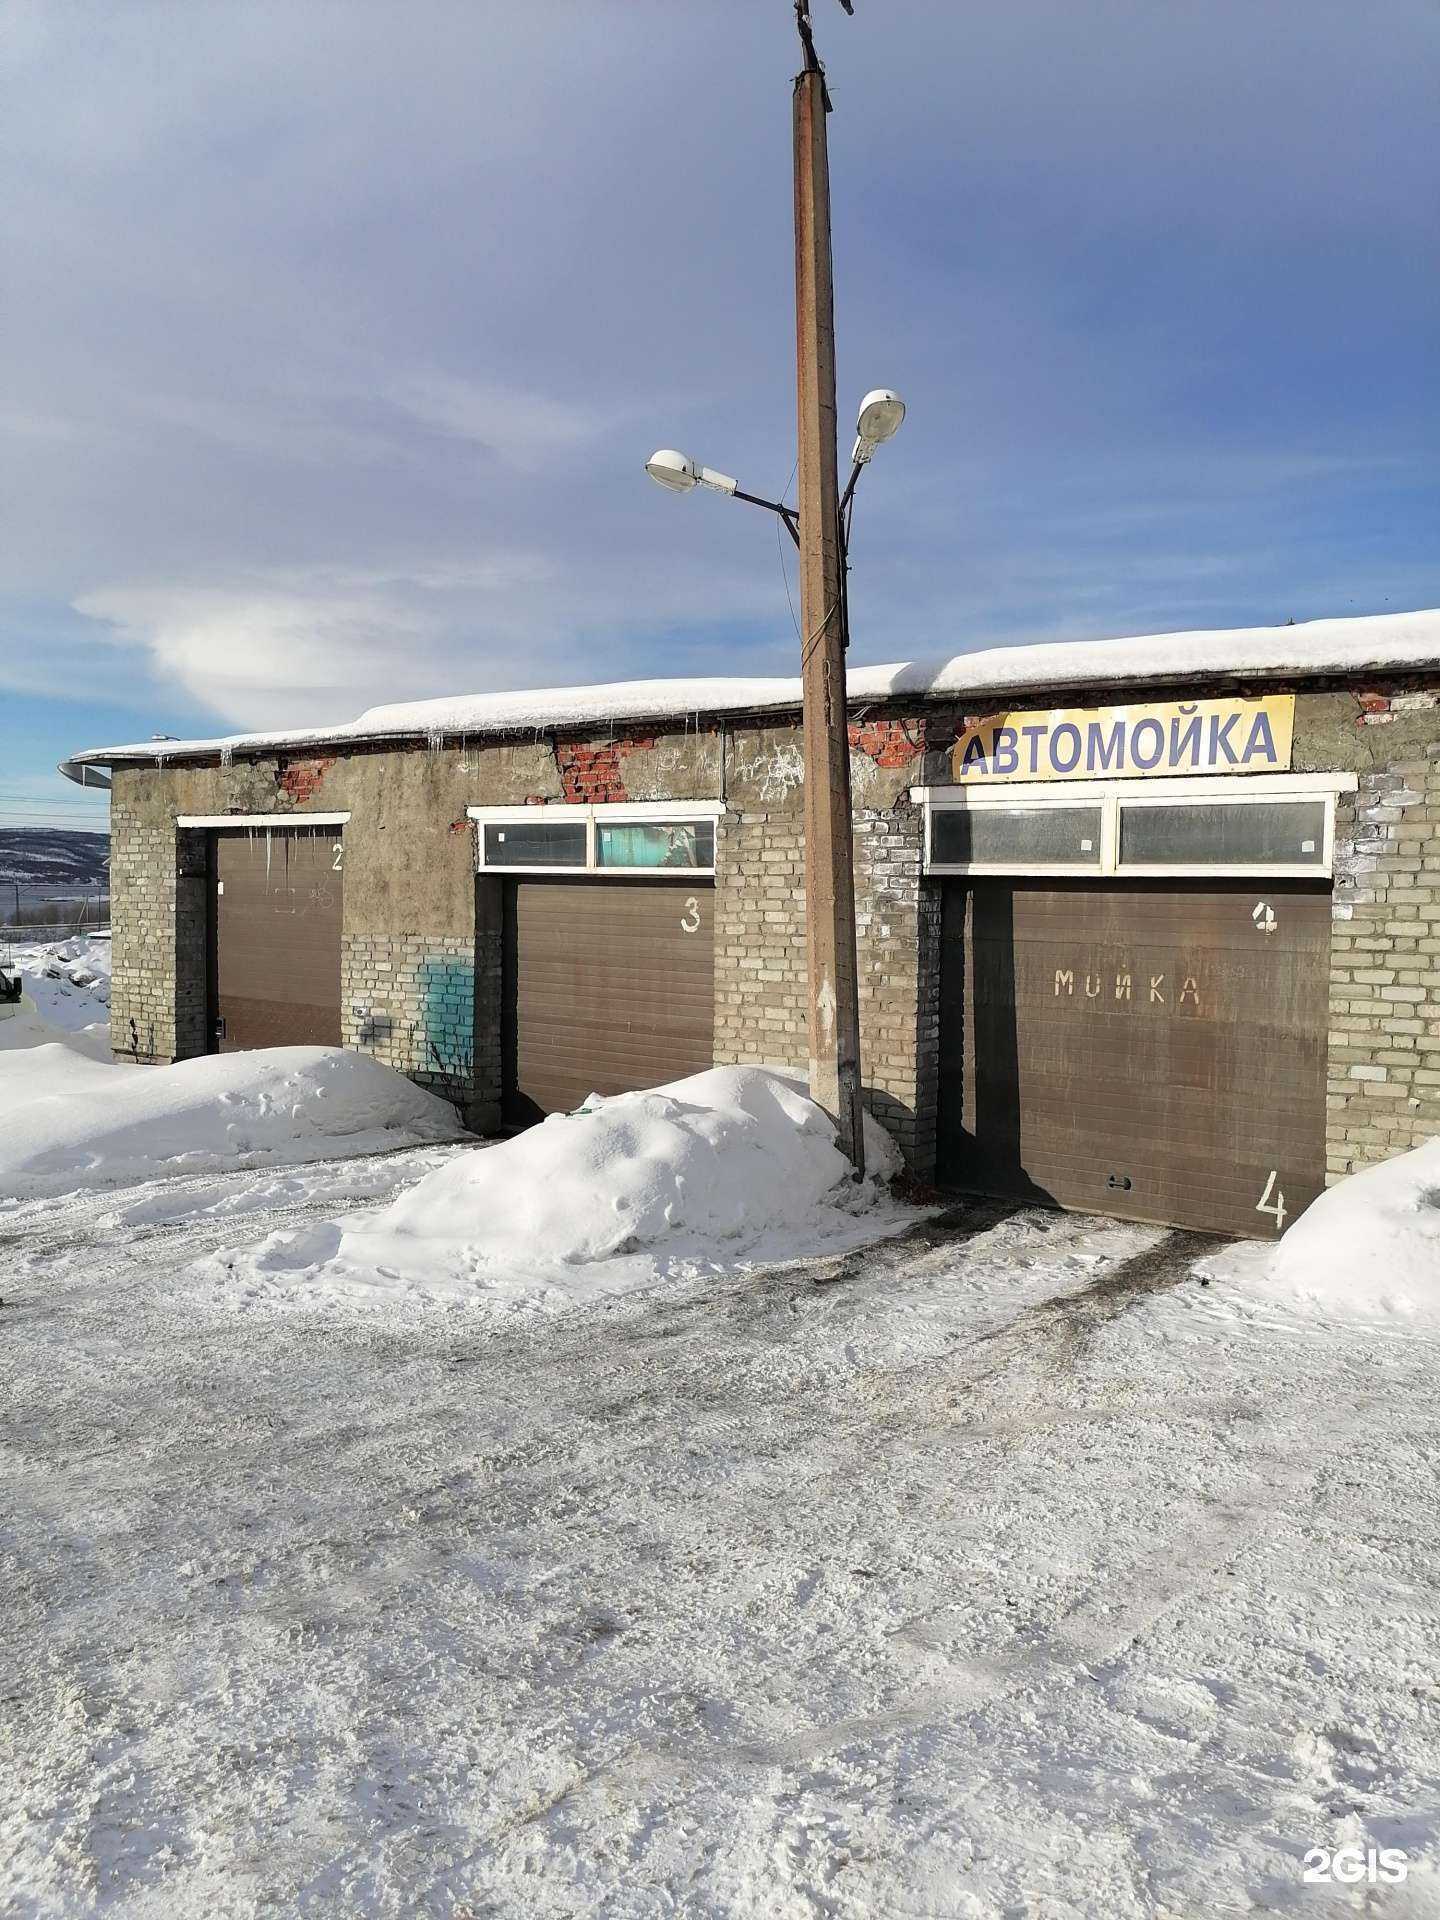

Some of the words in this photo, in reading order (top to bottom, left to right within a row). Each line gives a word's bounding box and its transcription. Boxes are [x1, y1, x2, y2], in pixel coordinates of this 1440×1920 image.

[961, 705, 1277, 776] АВТОМОЙКА
[332, 843, 343, 871] 2
[681, 897, 700, 932] 3
[1255, 1171, 1287, 1229] 4
